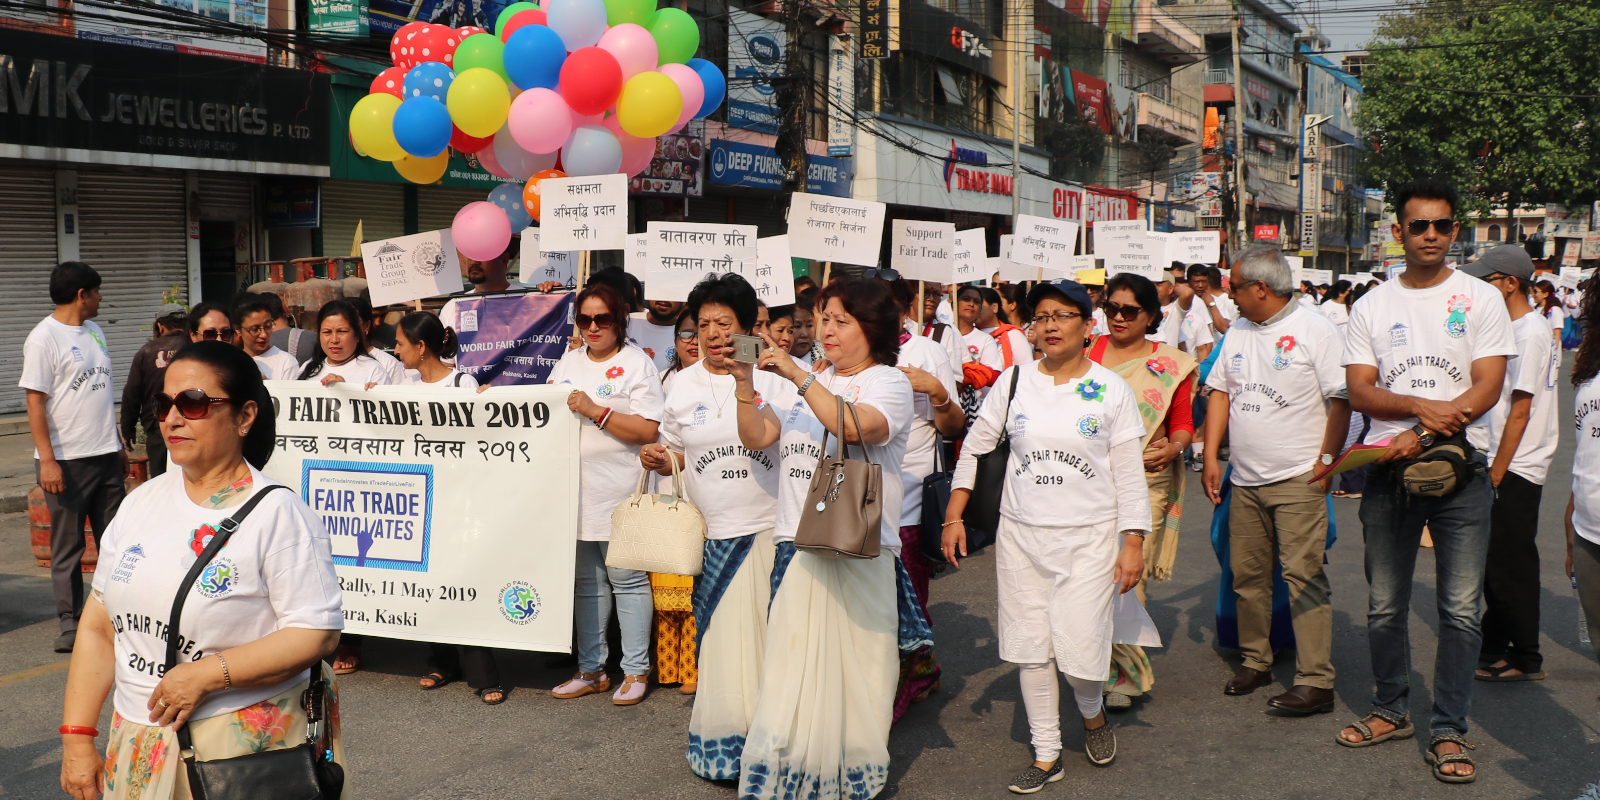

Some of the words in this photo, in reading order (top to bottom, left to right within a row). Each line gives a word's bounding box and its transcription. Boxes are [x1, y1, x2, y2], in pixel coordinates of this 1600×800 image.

[101, 92, 268, 136] JEWELLERIES
[1307, 116, 1316, 156] ZARA
[728, 152, 752, 172] DEEP
[808, 164, 837, 183] CENTRE
[567, 183, 602, 196] सक्षमता
[956, 168, 990, 194] TRADE
[553, 203, 588, 222] अभिवृद्धि
[593, 204, 616, 216] प्रदान
[1053, 188, 1082, 220] CITY
[1086, 192, 1129, 222] CENTER
[573, 224, 590, 240] गरौं
[806, 217, 836, 232] रोजगार
[839, 220, 868, 235] सिर्जना
[906, 226, 943, 242] Support
[1034, 224, 1060, 236] सक्षमता
[659, 230, 718, 245] वातावरण
[723, 228, 748, 247] प्रति
[1022, 236, 1047, 250] अभिवृद्धि
[1050, 241, 1066, 252] प्रदान
[378, 253, 402, 264] Fair
[900, 244, 918, 258] Fair
[920, 246, 948, 260] Trade
[379, 260, 404, 271] Trade
[660, 256, 704, 270] सम्मान
[711, 254, 734, 273] गरौं
[380, 269, 406, 280] Group
[382, 278, 410, 288] NEPAL
[460, 341, 494, 352] WORLD
[496, 340, 515, 350] FAIR
[544, 335, 562, 344] DAY
[1386, 363, 1406, 388] WORLD
[1406, 356, 1422, 368] FAIR
[1426, 356, 1450, 371] TRADE
[1448, 366, 1463, 382] DAY
[92, 382, 106, 392] 2019
[1411, 379, 1436, 388] 2019
[1244, 383, 1257, 392] FAIR
[1258, 384, 1277, 399] TRADE
[1274, 396, 1290, 410] DAY
[288, 397, 342, 423] FAIR
[350, 398, 425, 426] TRADE
[428, 401, 476, 428] DAY
[485, 401, 550, 428] 2019
[1242, 403, 1260, 412] 2019
[328, 436, 404, 457] व्यवसाय
[414, 433, 466, 460] दिवस
[478, 440, 531, 463] २०१९
[790, 443, 805, 455] FAIR
[696, 454, 716, 474] WORLD
[716, 445, 736, 458] FAIR
[738, 445, 762, 462] TRADE
[762, 456, 774, 472] DAY
[1032, 450, 1050, 462] FAIR
[1054, 450, 1082, 468] TRADE
[1080, 463, 1096, 480] DAY
[320, 476, 368, 486] #FairTradeInnovates
[369, 480, 416, 488] #TradeFairLiveFair
[722, 469, 748, 479] 2019
[790, 468, 812, 480] 2019
[1036, 475, 1064, 484] 2019
[314, 488, 356, 513] FAIR
[360, 491, 420, 517] TRADE
[322, 515, 414, 541] INNOVATES
[118, 560, 136, 571] Trade
[122, 553, 141, 564] Fair
[337, 576, 376, 597] Rally,
[380, 580, 394, 596] 11
[401, 583, 434, 603] May
[439, 585, 478, 602] 2019
[498, 582, 512, 604] WORLD
[528, 582, 542, 608] TRADE
[375, 608, 418, 628] Kaski
[499, 606, 540, 626] ORGANIZATION
[126, 613, 150, 634] FAIR
[156, 620, 196, 655] TRDE
[128, 653, 166, 678] 2019
